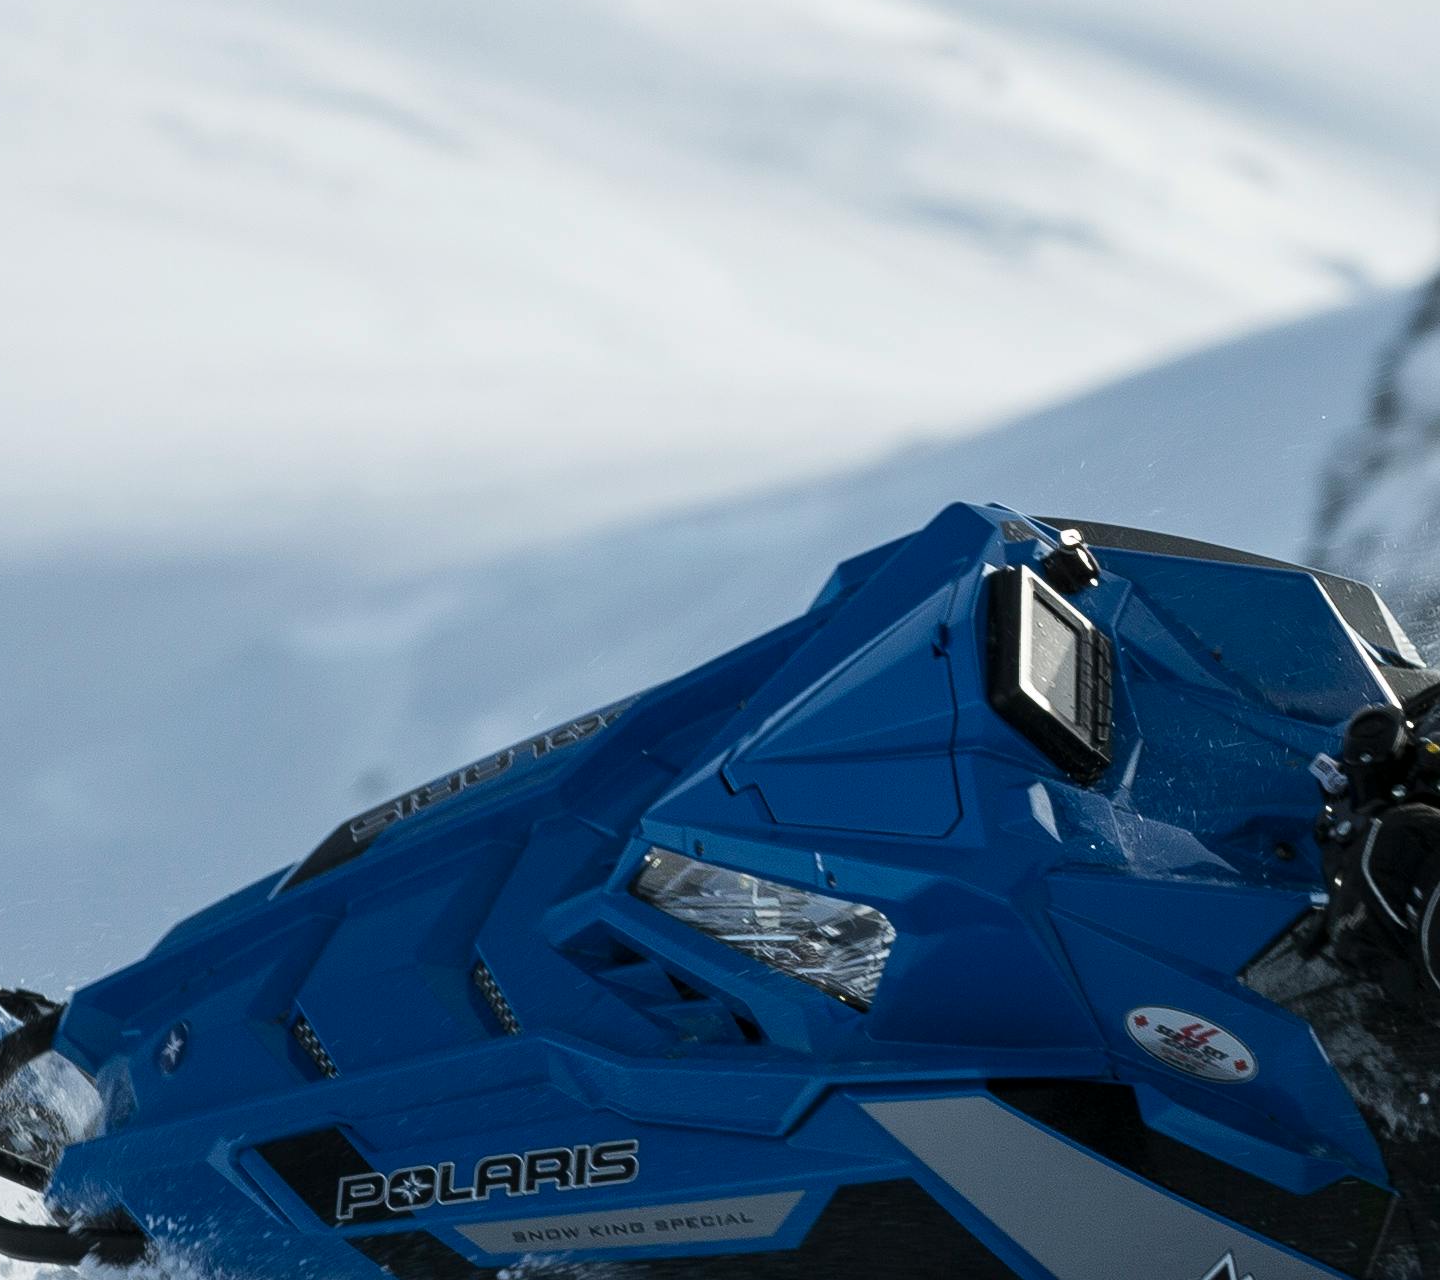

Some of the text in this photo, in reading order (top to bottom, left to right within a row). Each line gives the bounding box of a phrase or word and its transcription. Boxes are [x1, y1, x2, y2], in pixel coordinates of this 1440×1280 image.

[336, 1139, 640, 1219] POLARIS
[512, 1212, 754, 1243] SNOW KING SPECIAL
